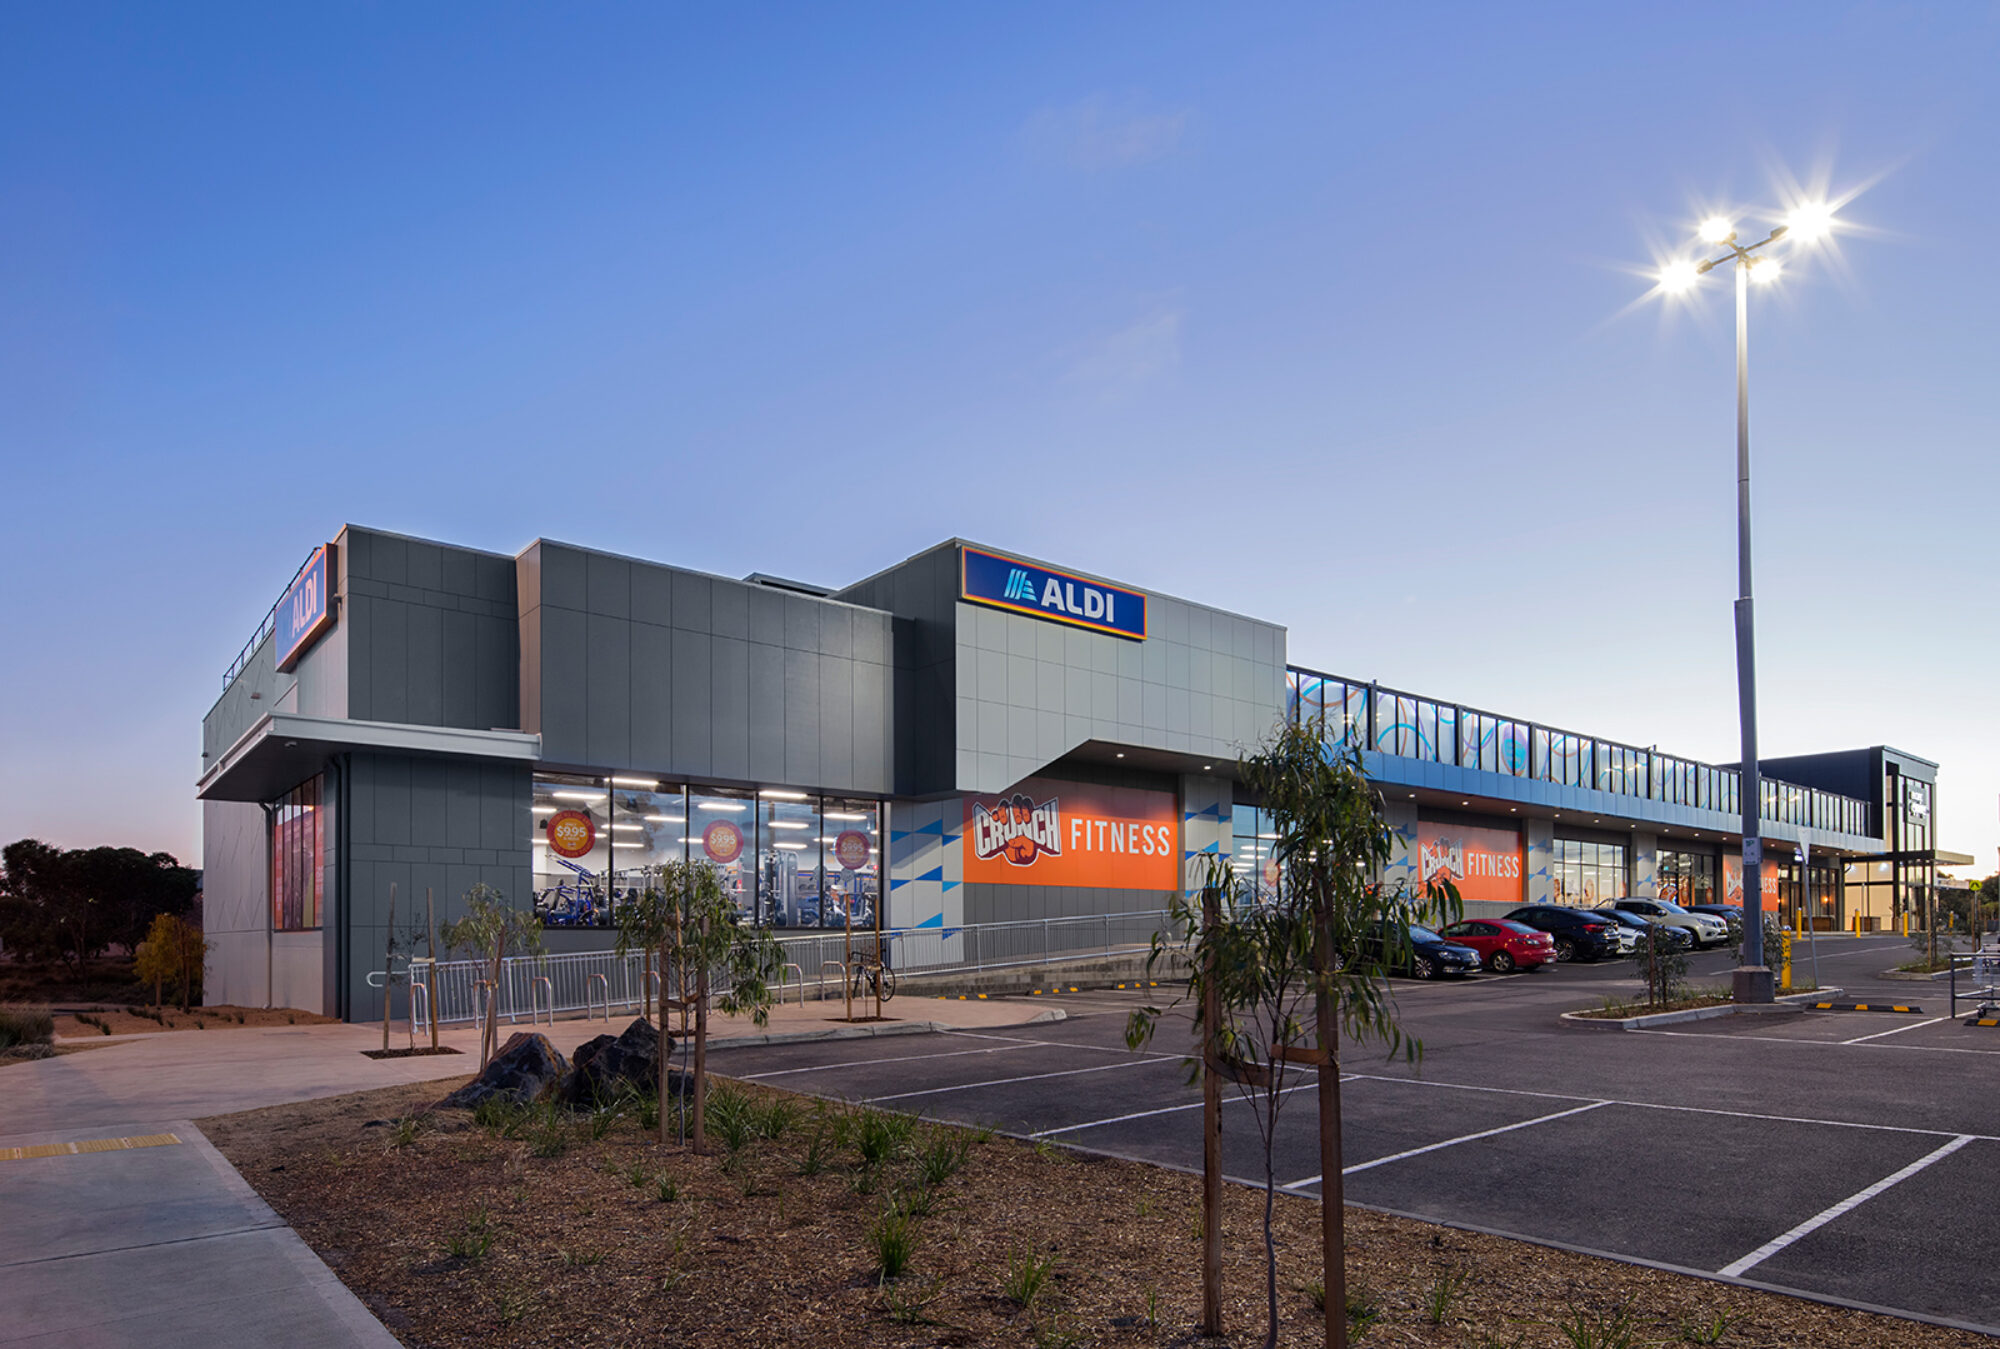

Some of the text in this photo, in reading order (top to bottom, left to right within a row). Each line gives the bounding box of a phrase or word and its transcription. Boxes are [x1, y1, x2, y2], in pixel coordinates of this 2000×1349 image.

[291, 570, 317, 639] ALDI
[1041, 577, 1114, 623] ALDI
[976, 801, 1170, 857] CRUNCH FITNESS
[1422, 839, 1520, 881] CRUNCH FITNESS
